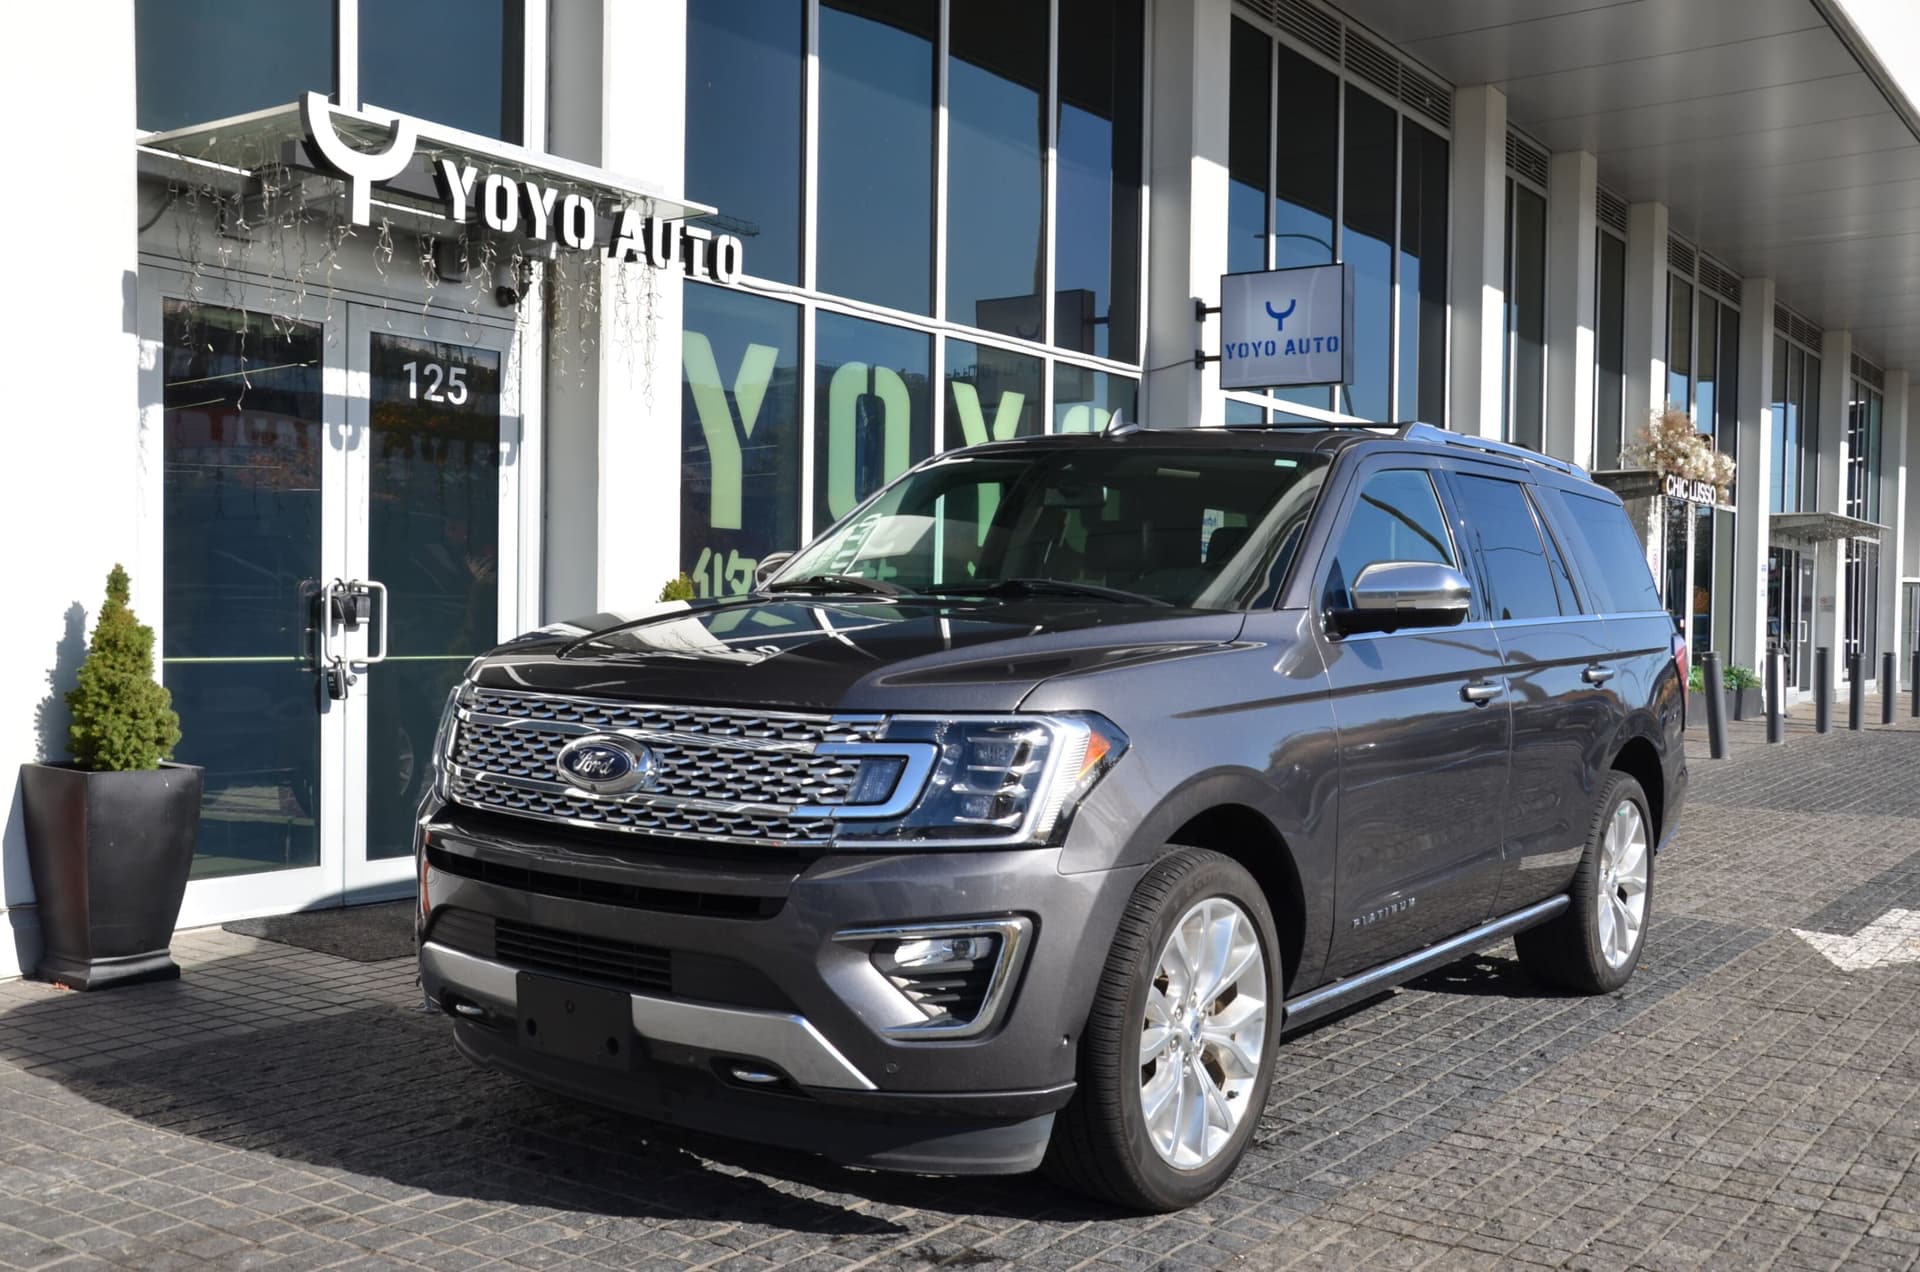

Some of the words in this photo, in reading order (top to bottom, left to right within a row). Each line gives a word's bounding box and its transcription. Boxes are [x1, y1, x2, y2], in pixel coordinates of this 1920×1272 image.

[439, 157, 596, 250] YOYO
[613, 209, 743, 284] AUTO
[1225, 340, 1276, 360] YOYO
[1284, 336, 1339, 355] AUTO
[403, 361, 468, 405] 125
[677, 330, 1113, 530] YOY
[1666, 474, 1688, 499] CHIC
[1689, 480, 1716, 505] LUSSO
[573, 748, 615, 776] Ford
